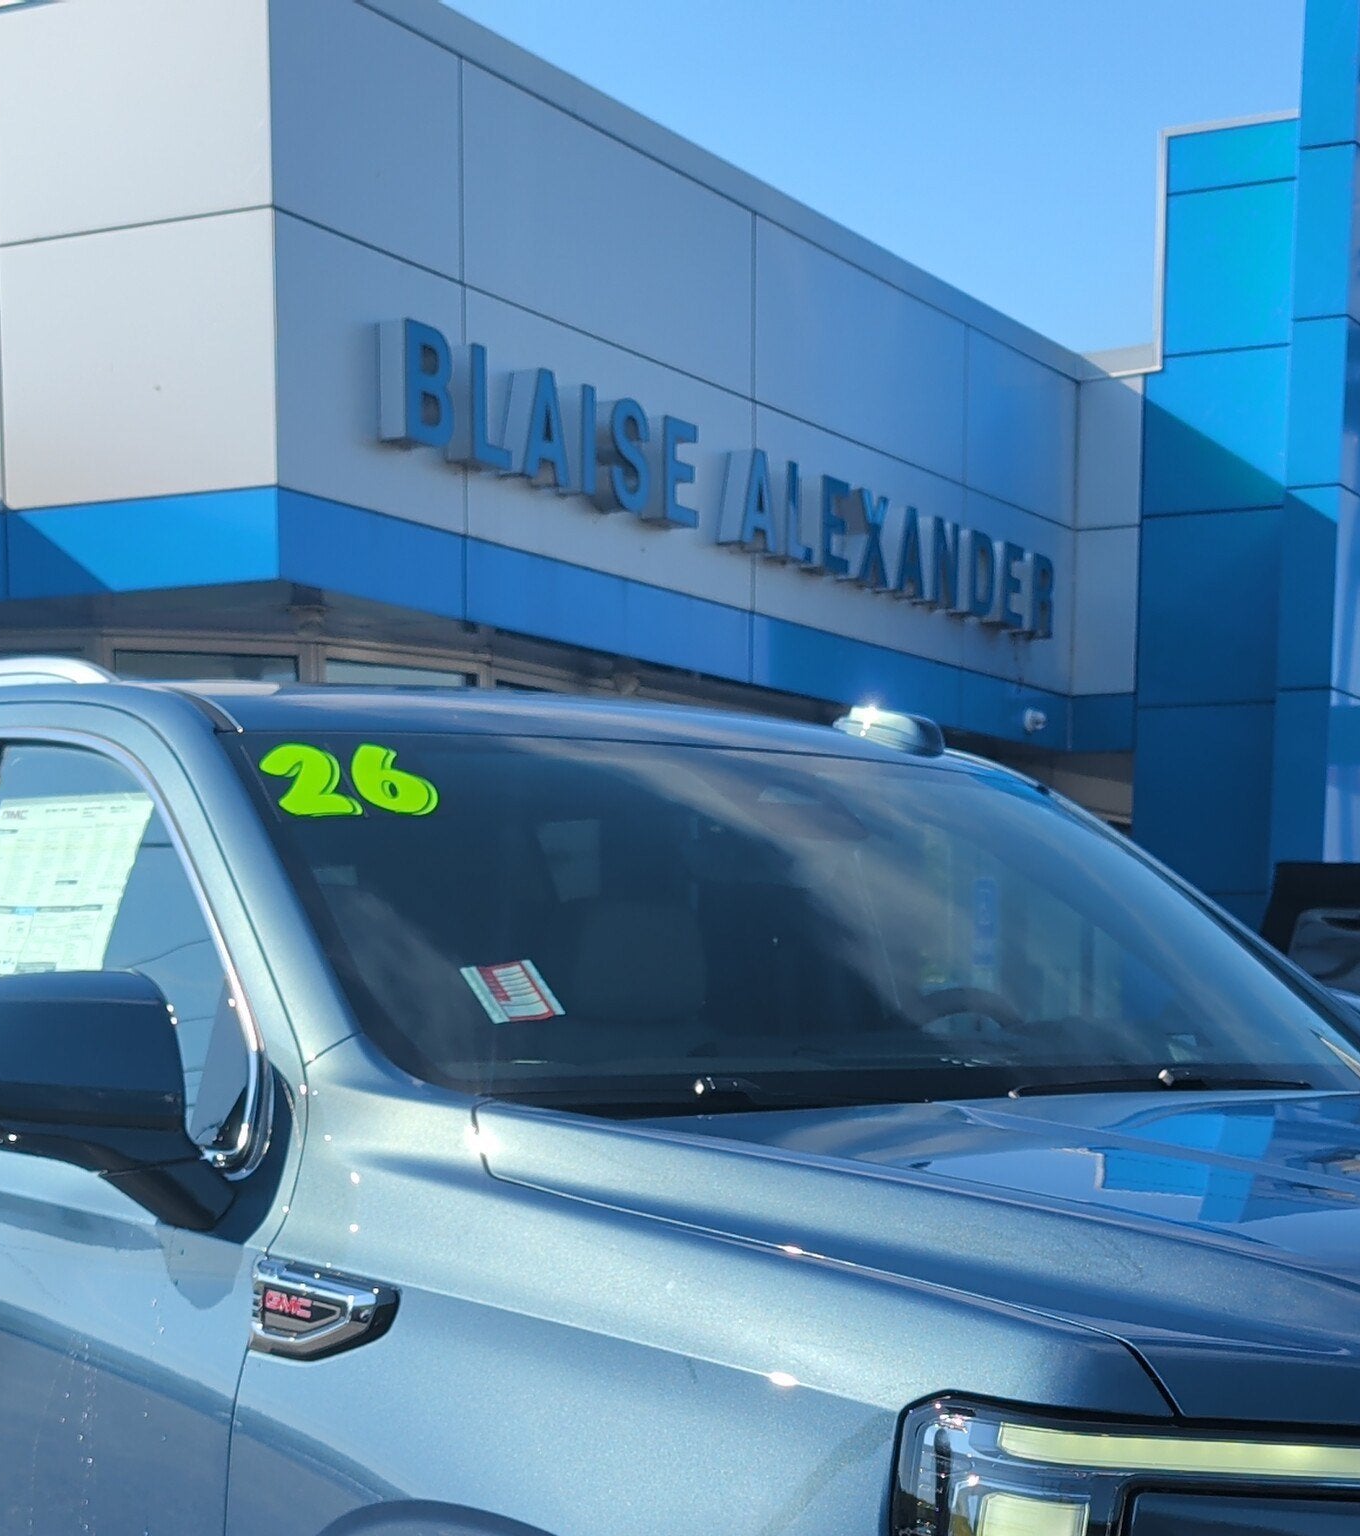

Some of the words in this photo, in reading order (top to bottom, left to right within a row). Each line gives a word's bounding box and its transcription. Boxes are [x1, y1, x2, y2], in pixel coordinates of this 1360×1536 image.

[392, 316, 700, 530] BLAISE
[730, 448, 1055, 640] ALEXANDER
[258, 742, 440, 817] 26
[265, 1289, 313, 1320] GMC
